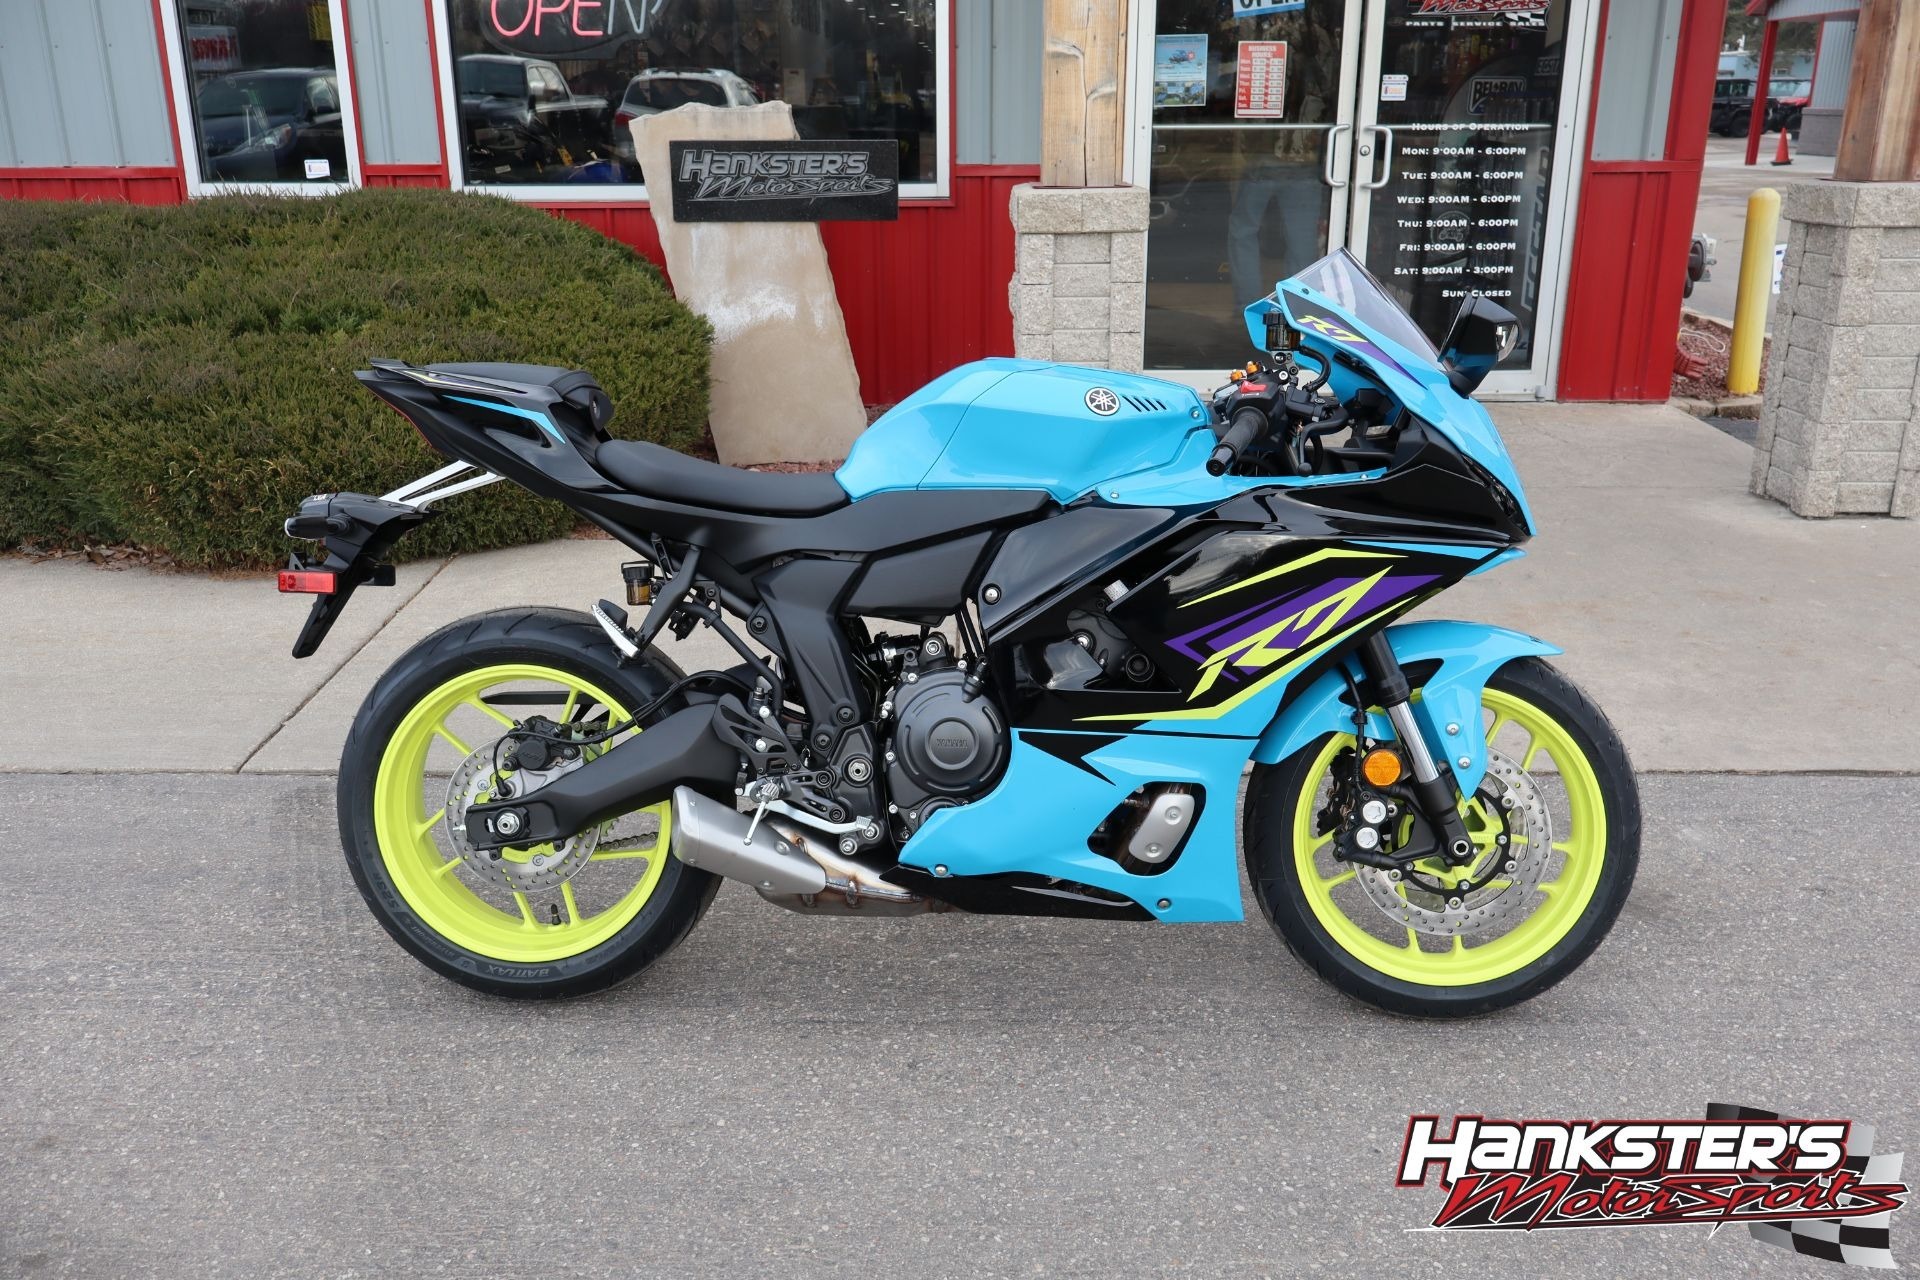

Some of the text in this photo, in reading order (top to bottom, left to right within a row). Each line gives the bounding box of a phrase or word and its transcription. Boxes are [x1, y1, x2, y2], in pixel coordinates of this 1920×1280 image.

[1485, 147, 1526, 155] 6:00PM
[1430, 171, 1472, 179] 9:00AM
[1482, 171, 1523, 179] 6:00PM
[1428, 195, 1470, 203] 9:00AM
[1480, 195, 1521, 203] 6:00PM
[1426, 219, 1468, 227] 9:00AM
[1478, 219, 1519, 227] 6:00PM
[1424, 242, 1465, 251] 9:00AM
[1475, 242, 1516, 251] 6:00PM
[1421, 266, 1463, 275] 9:00AM
[1473, 265, 1514, 274] 3:00PM
[1186, 564, 1394, 703] R7
